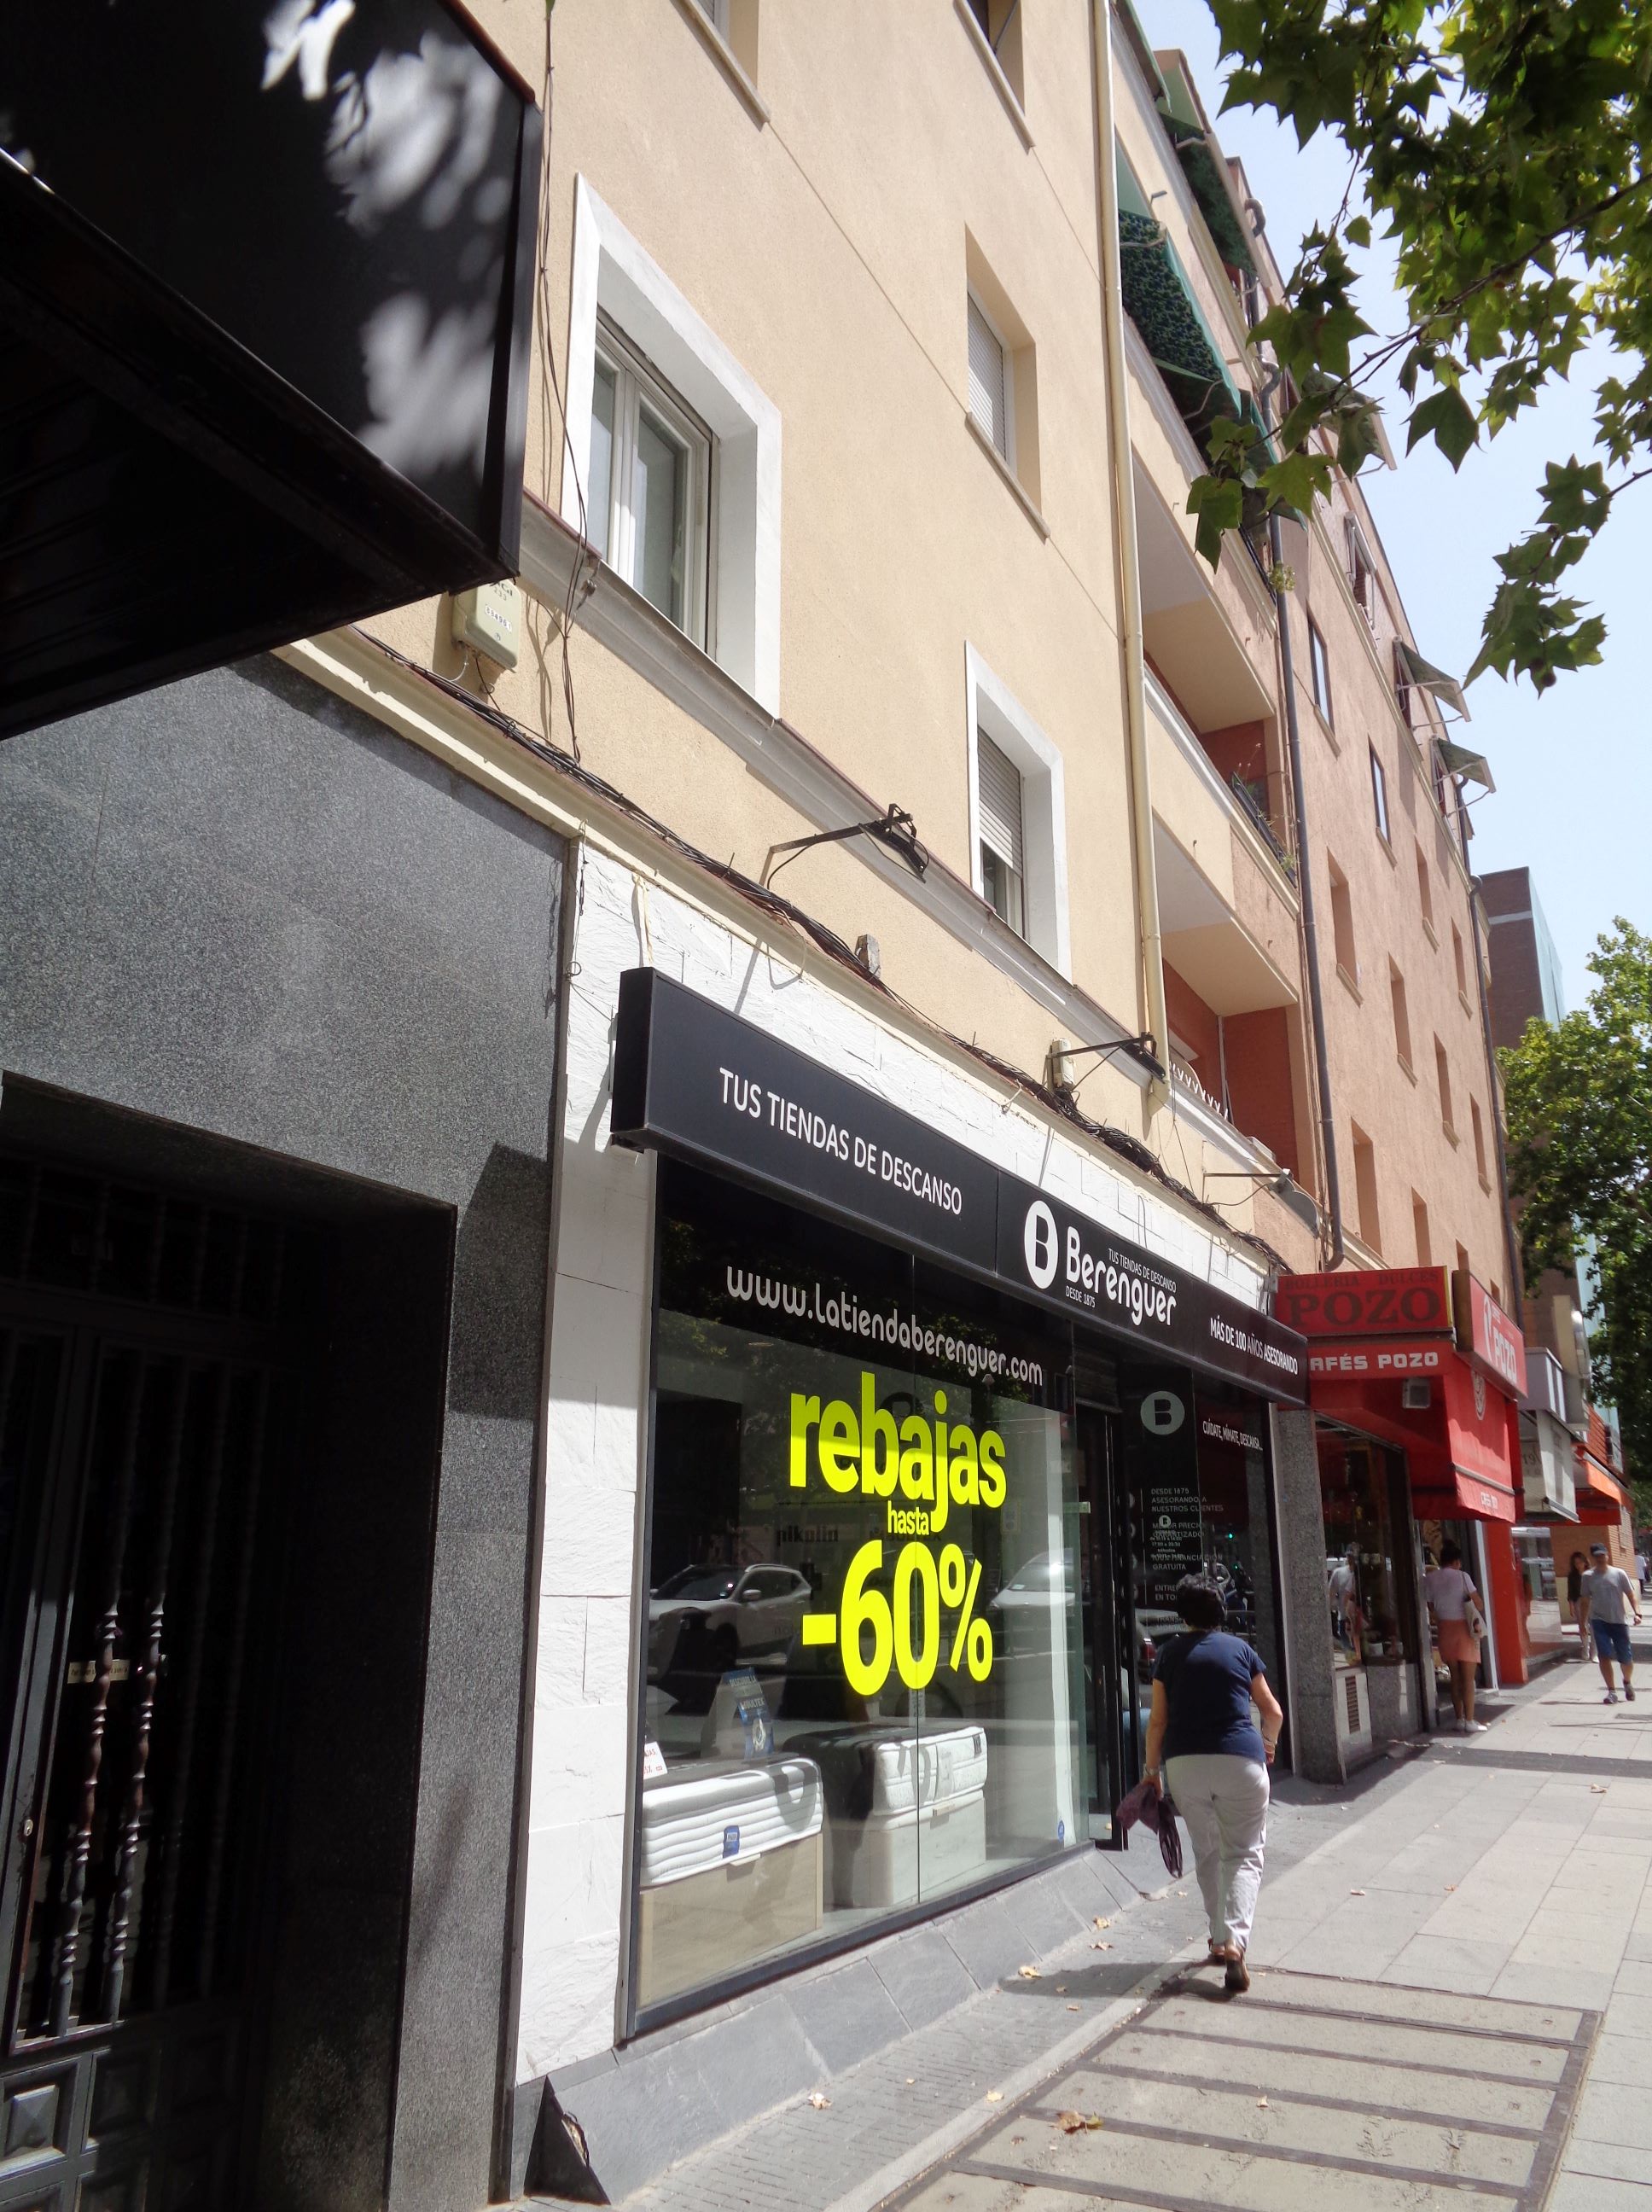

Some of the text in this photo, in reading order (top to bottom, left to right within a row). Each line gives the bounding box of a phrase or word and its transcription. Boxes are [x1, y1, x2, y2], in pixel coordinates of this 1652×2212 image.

[719, 1067, 963, 1215] TUS TIENDAS DE DESCANSO
[1066, 1285, 1096, 1307] DESDE 1875
[1067, 1225, 1177, 1325] Berenguer
[1108, 1248, 1177, 1293] TUS TIENDAS DE DESCANSO
[1378, 1271, 1439, 1285] DULCES
[727, 1266, 1043, 1386] www.latiendaberenguer.com
[1286, 1287, 1440, 1326] POZO
[1210, 1315, 1299, 1376] MÁS DE 100 AÑOS ASESORANDO
[1310, 1352, 1439, 1371] AFÉS POZO
[1492, 1325, 1517, 1383] POZO
[789, 1371, 1007, 1533] rebajas
[887, 1500, 930, 1535] hasta
[802, 1540, 993, 1696] -60%
